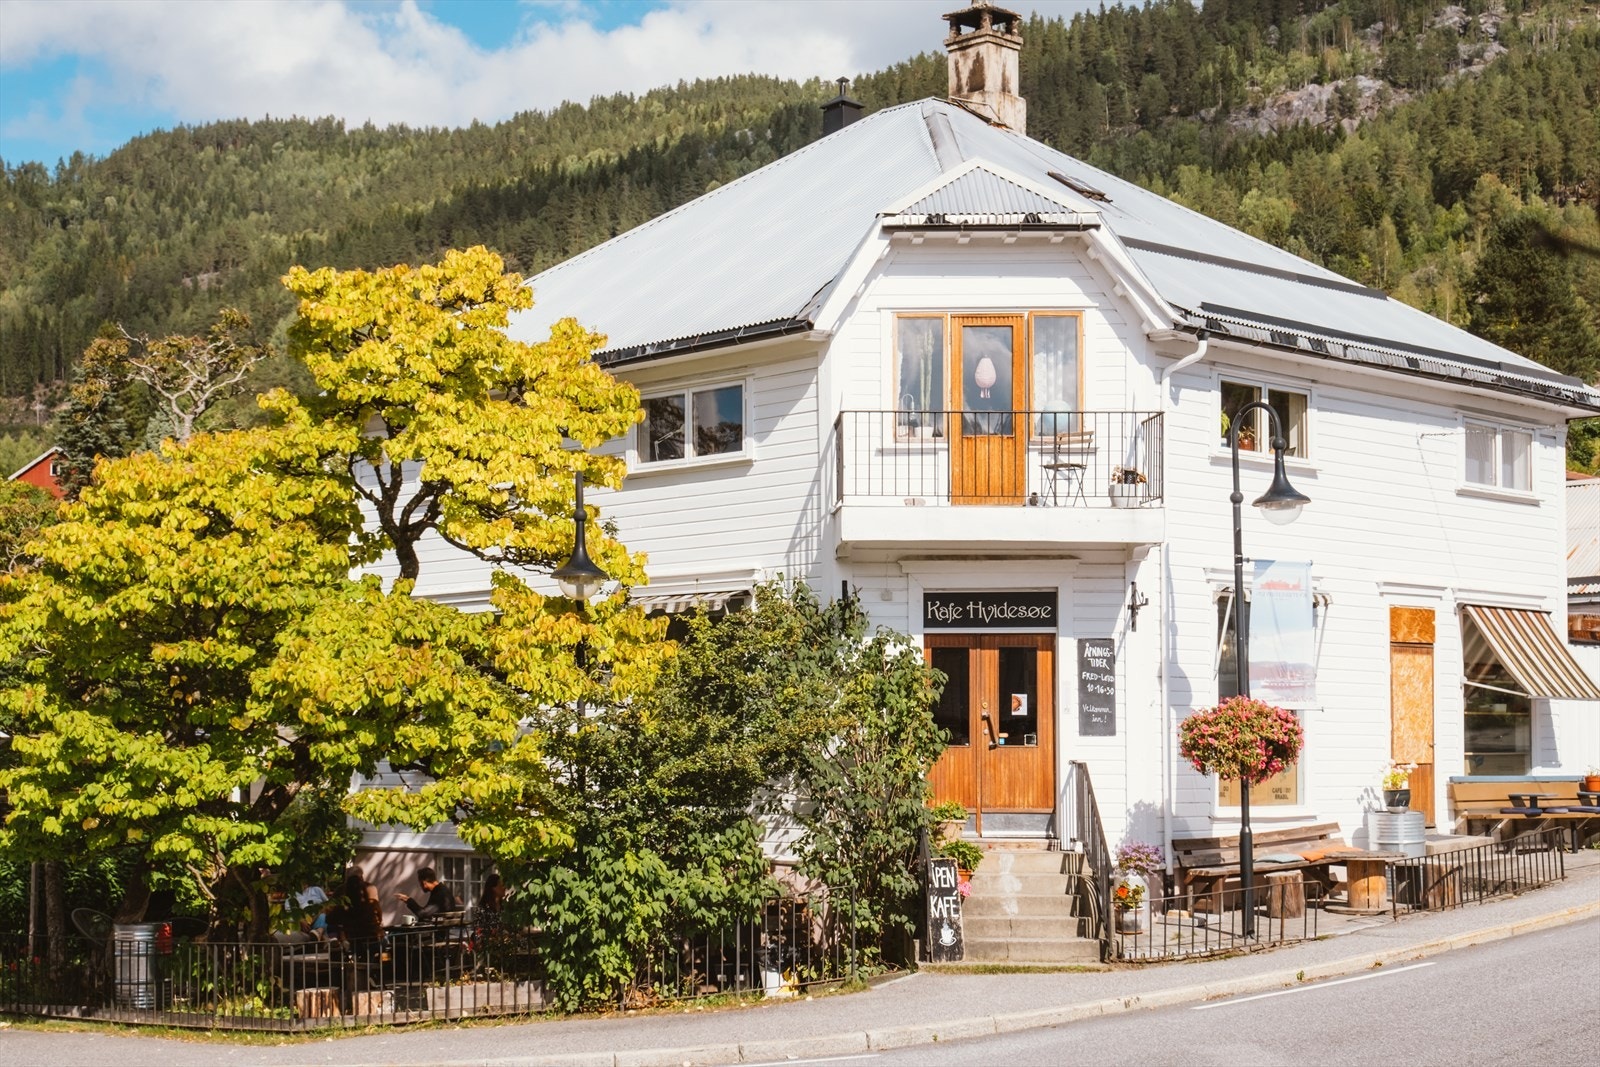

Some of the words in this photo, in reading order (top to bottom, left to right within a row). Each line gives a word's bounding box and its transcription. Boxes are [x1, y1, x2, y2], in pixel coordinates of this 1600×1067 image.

[927, 601, 962, 623] Kafe
[967, 601, 1051, 623] Hvidesøe
[1087, 658, 1110, 670] TIDER
[930, 890, 960, 918] KAFÉ
